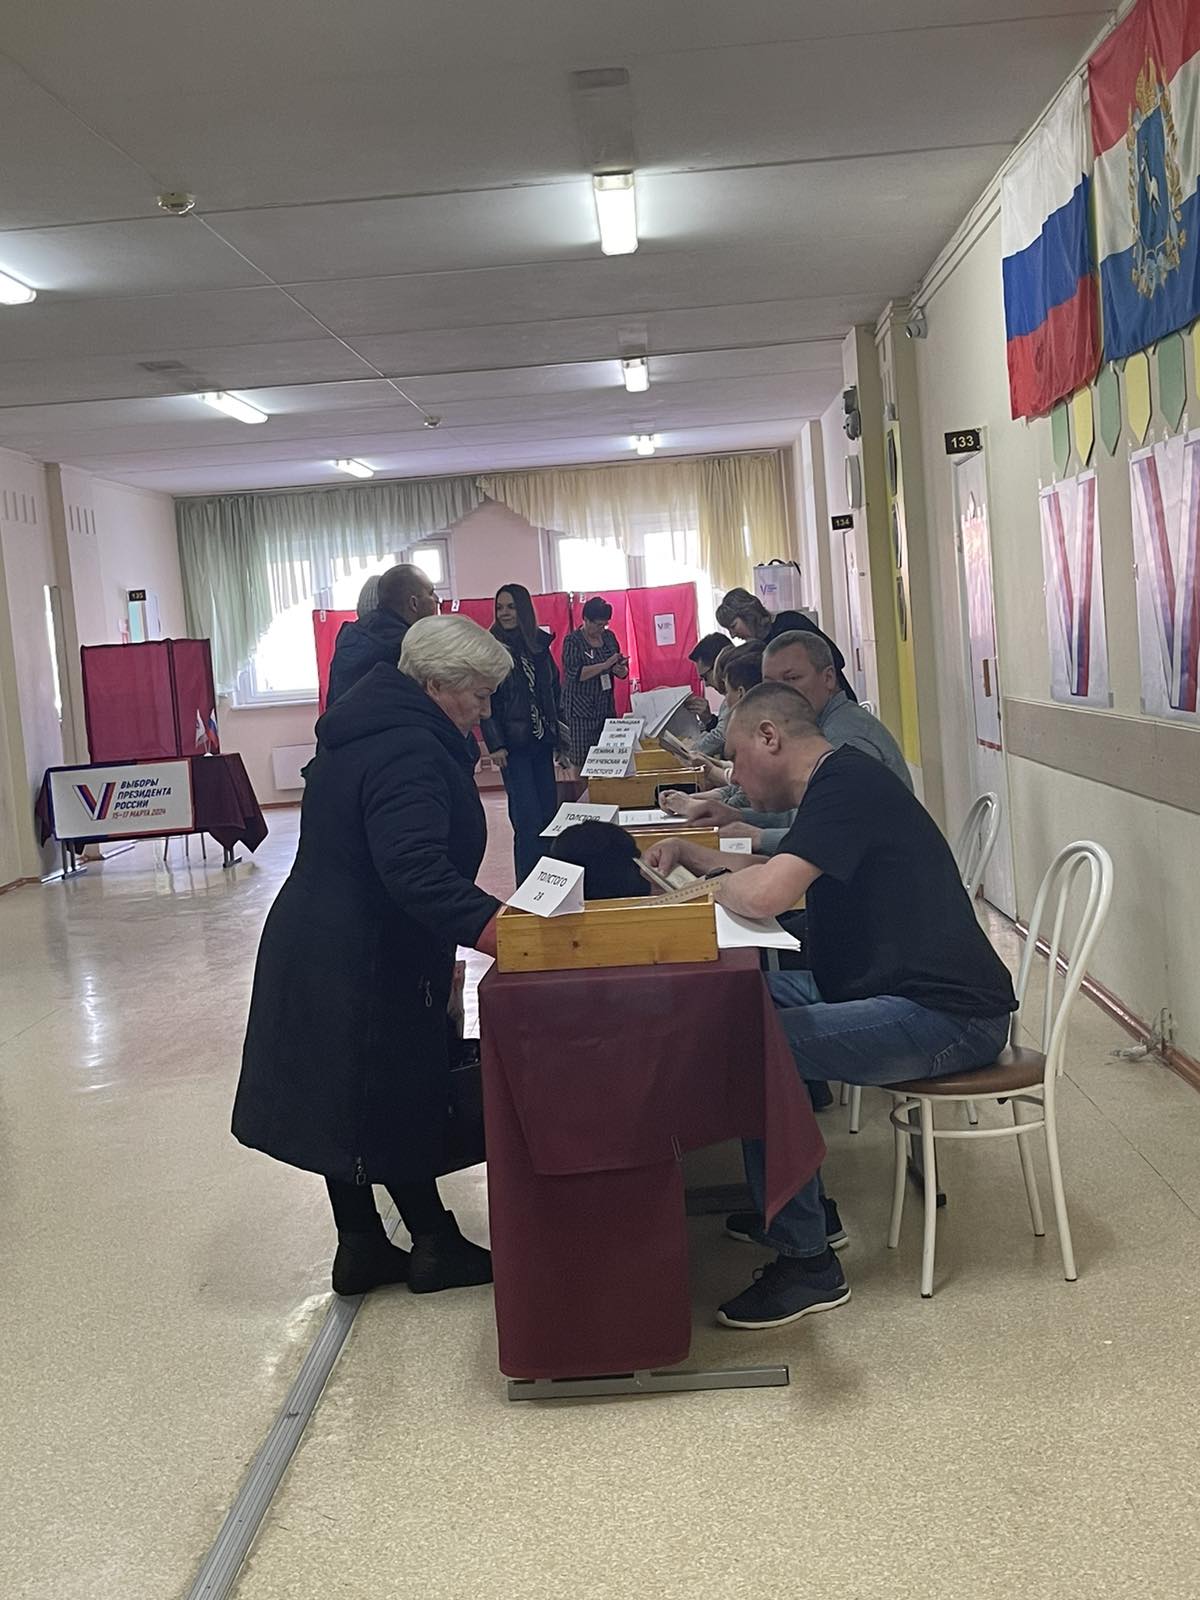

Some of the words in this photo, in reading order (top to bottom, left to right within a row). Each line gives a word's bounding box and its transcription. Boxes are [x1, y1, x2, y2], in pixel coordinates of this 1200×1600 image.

[951, 435, 974, 449] 133
[120, 778, 159, 790] ВЫБОРЫ
[117, 787, 172, 800] ПРЕЗИДЕНТА
[114, 800, 150, 811] РОССИИ
[130, 809, 150, 818] МАРТА
[537, 871, 568, 888] ТОЛСТОГО
